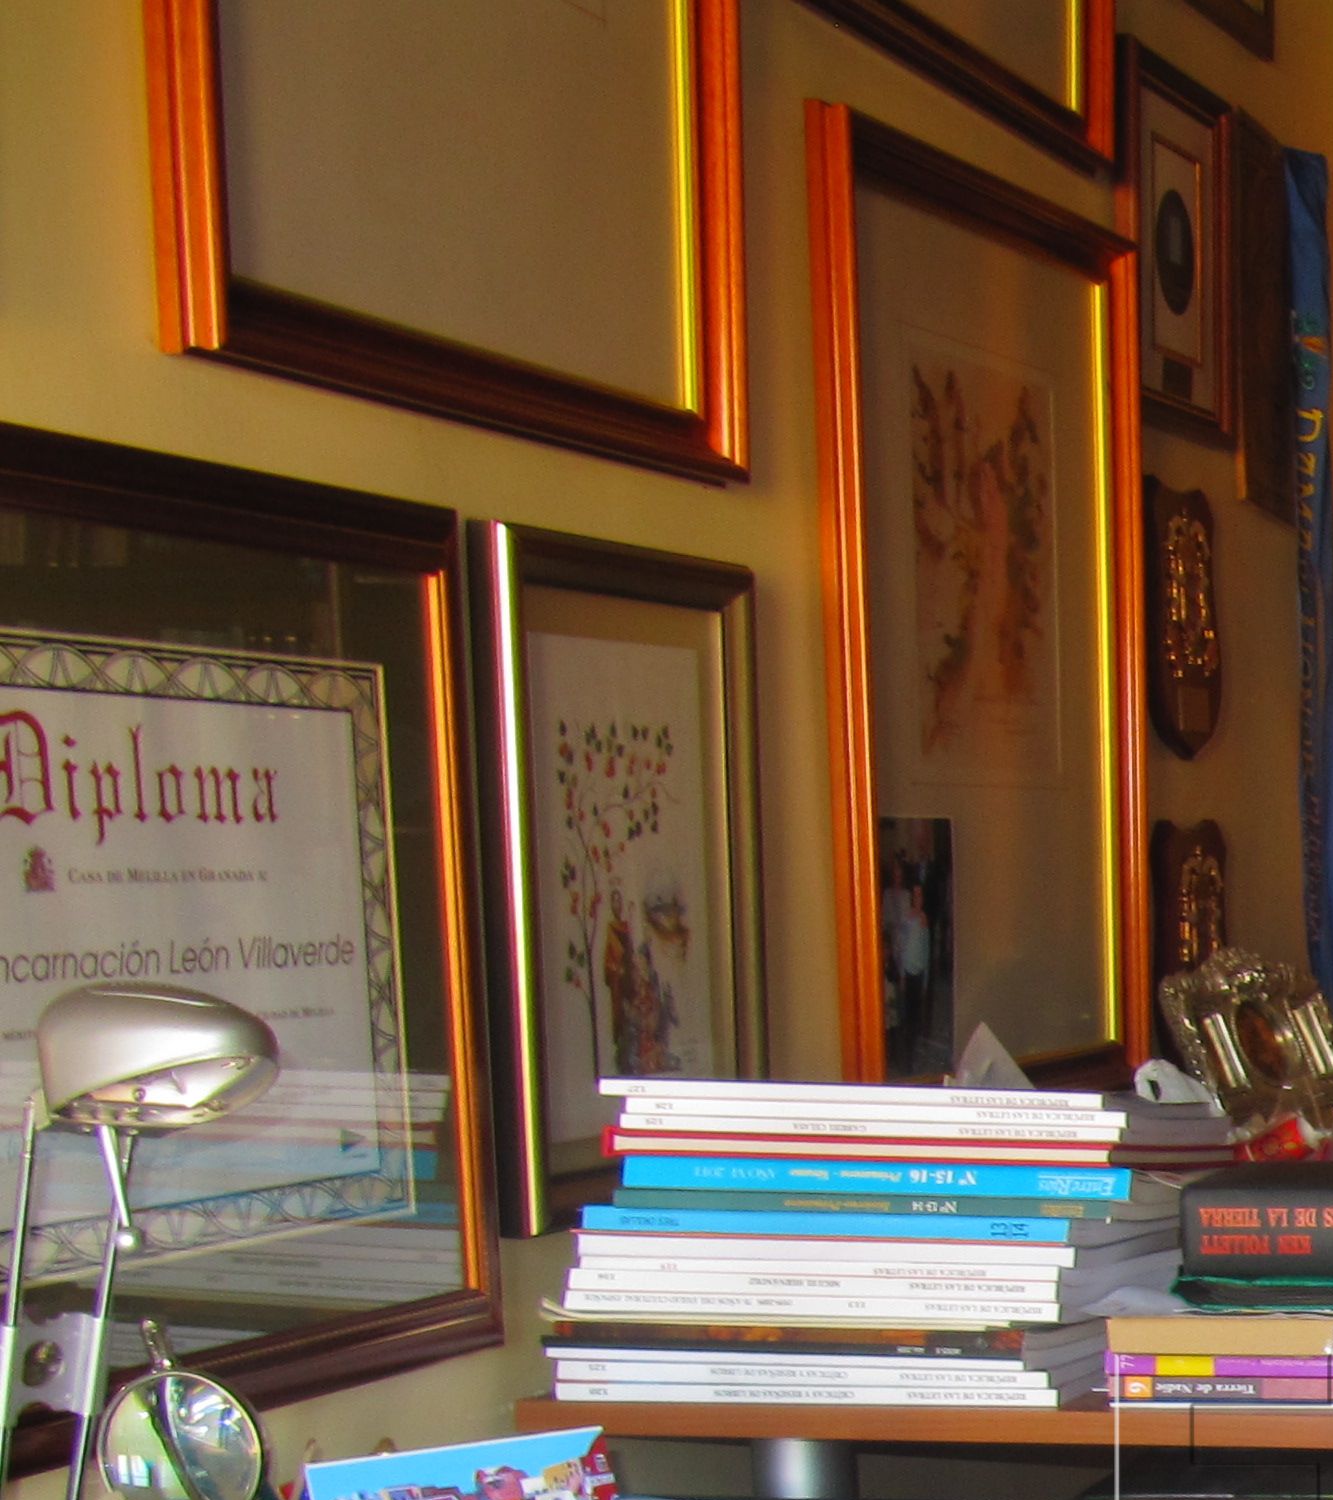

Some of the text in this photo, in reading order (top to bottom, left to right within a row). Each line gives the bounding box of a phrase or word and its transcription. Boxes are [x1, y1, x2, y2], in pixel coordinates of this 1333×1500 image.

[0, 710, 278, 846] Diploma
[0, 934, 356, 984] ncarnación León Villaverde
[909, 1169, 954, 1185] 15-16
[1199, 1208, 1263, 1227] TIERRA
[1266, 1208, 1290, 1227] LA
[1295, 1208, 1317, 1227] DE
[990, 1223, 1008, 1238] 13
[1012, 1223, 1030, 1238] 14
[1155, 1382, 1257, 1395] Tierra de Nadie
